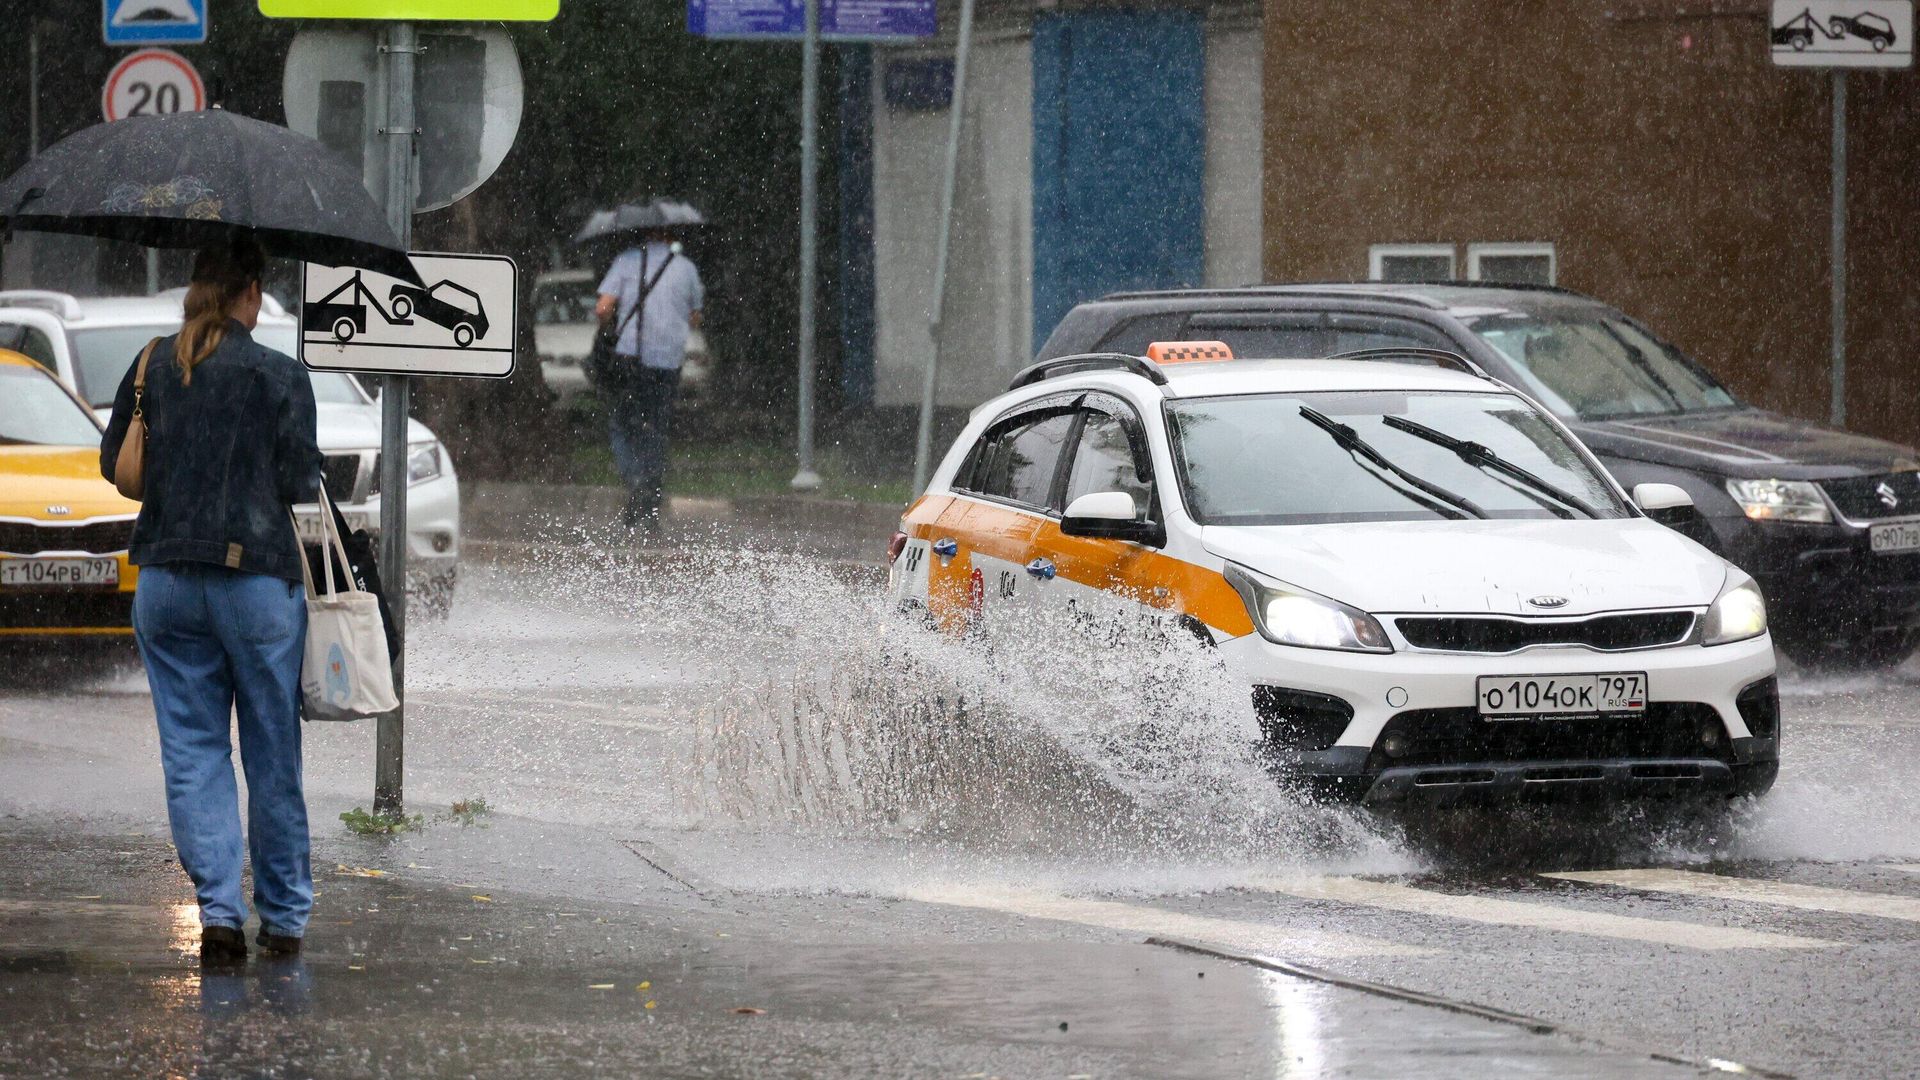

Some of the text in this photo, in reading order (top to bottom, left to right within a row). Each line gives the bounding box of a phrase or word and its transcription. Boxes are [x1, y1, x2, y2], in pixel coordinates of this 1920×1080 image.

[128, 82, 180, 117] 20
[8, 561, 111, 581] Т104РВ 797
[1487, 677, 1639, 709] О104ОК 797
[1608, 699, 1627, 707] RUS
